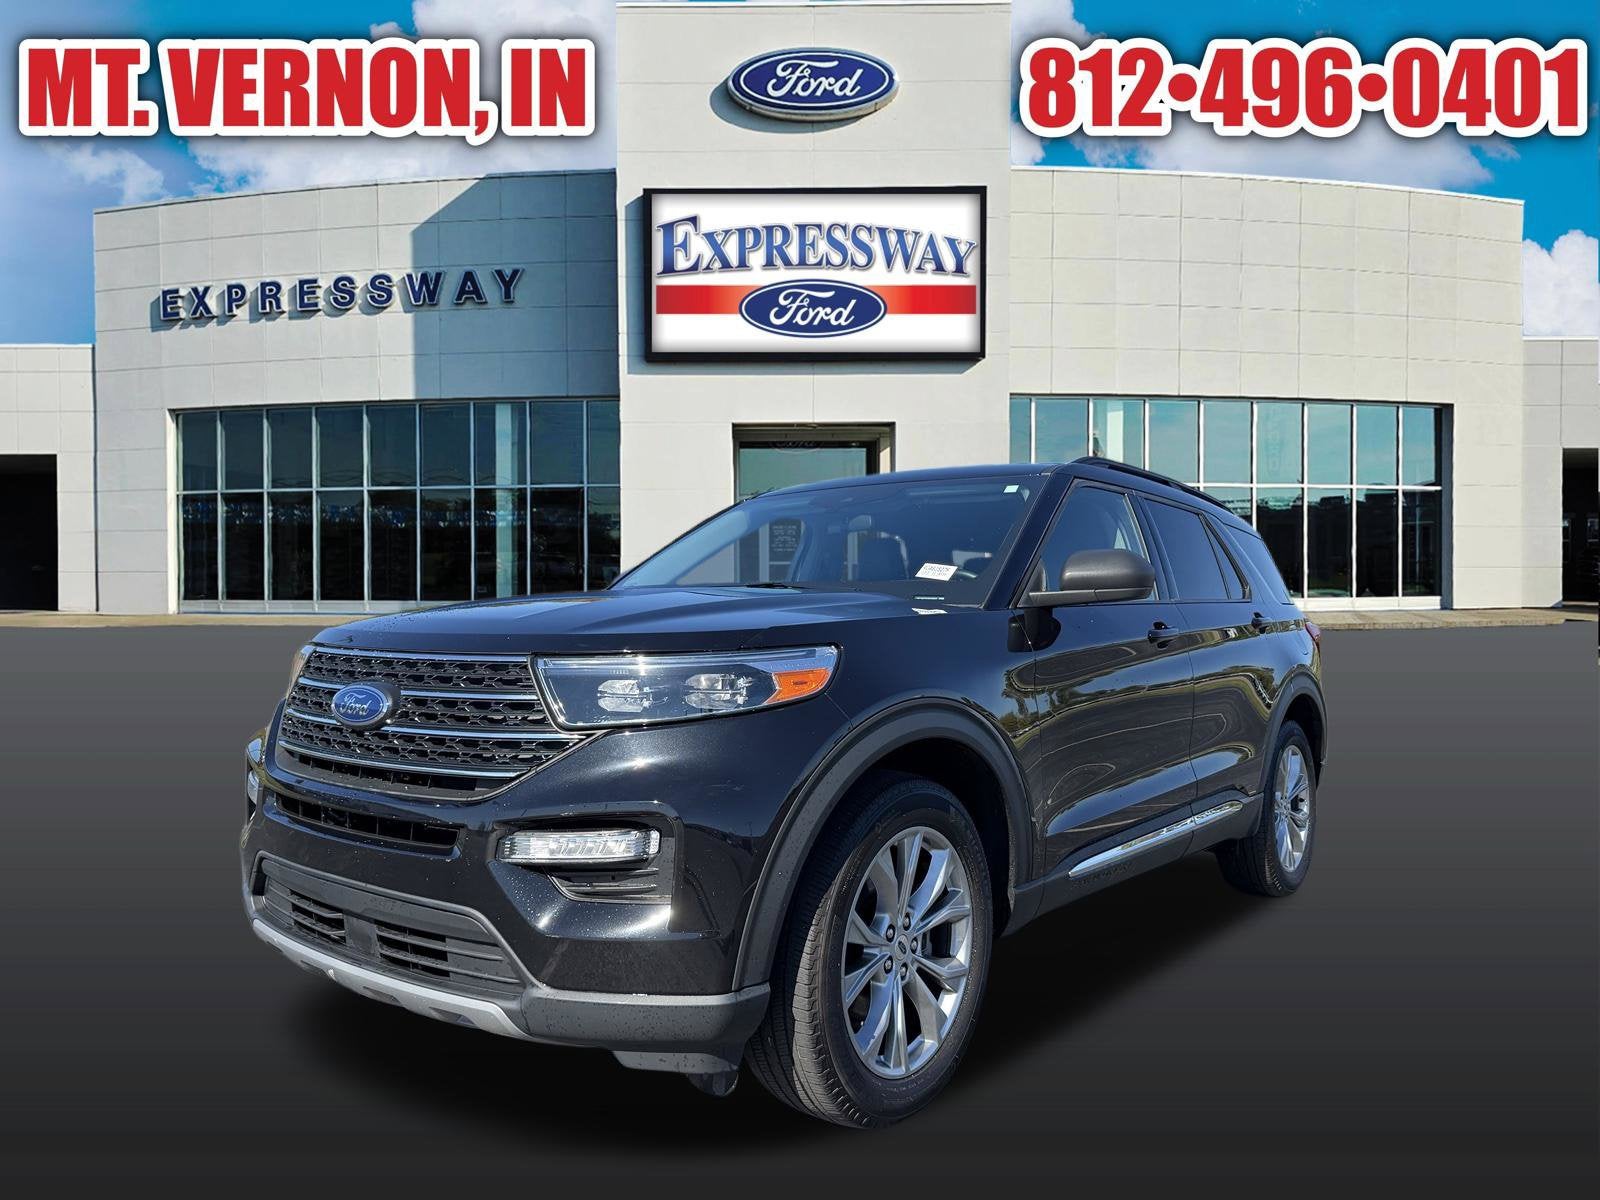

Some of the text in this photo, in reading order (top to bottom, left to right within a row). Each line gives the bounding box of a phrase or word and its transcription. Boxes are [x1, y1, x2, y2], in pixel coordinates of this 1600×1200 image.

[766, 59, 864, 98] Ford
[656, 214, 977, 278] EXPRESSWAY
[160, 268, 524, 321] EXPRESSWAY
[779, 289, 856, 328] Ford
[340, 692, 372, 716] Ford
